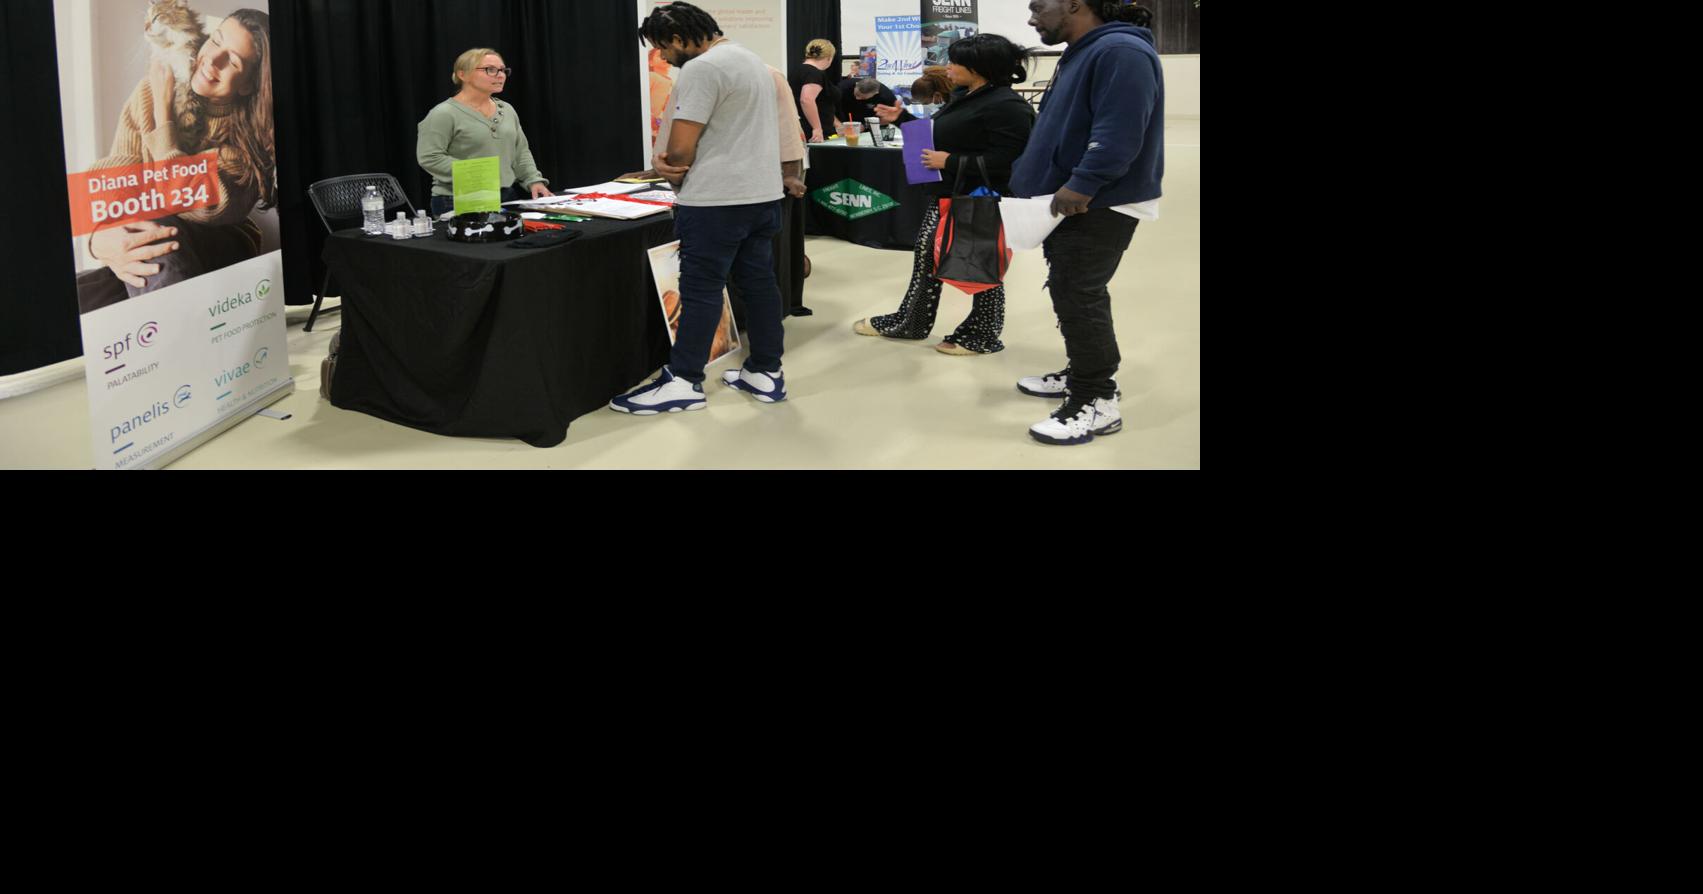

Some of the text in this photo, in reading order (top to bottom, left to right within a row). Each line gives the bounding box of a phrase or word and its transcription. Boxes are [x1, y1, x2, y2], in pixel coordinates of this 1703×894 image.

[955, 6, 972, 14] LINES
[88, 160, 208, 194] Diana Pet Food
[91, 184, 210, 223] Booth 234
[829, 191, 872, 209] SENN
[208, 291, 253, 317] videka
[103, 333, 132, 362] spf
[211, 333, 223, 345] PET
[224, 326, 242, 339] FOOD
[106, 361, 160, 390] PALATABILITY
[214, 362, 250, 387] vivae
[110, 400, 170, 444] panelis
[114, 432, 175, 469] MEASUREMENT
